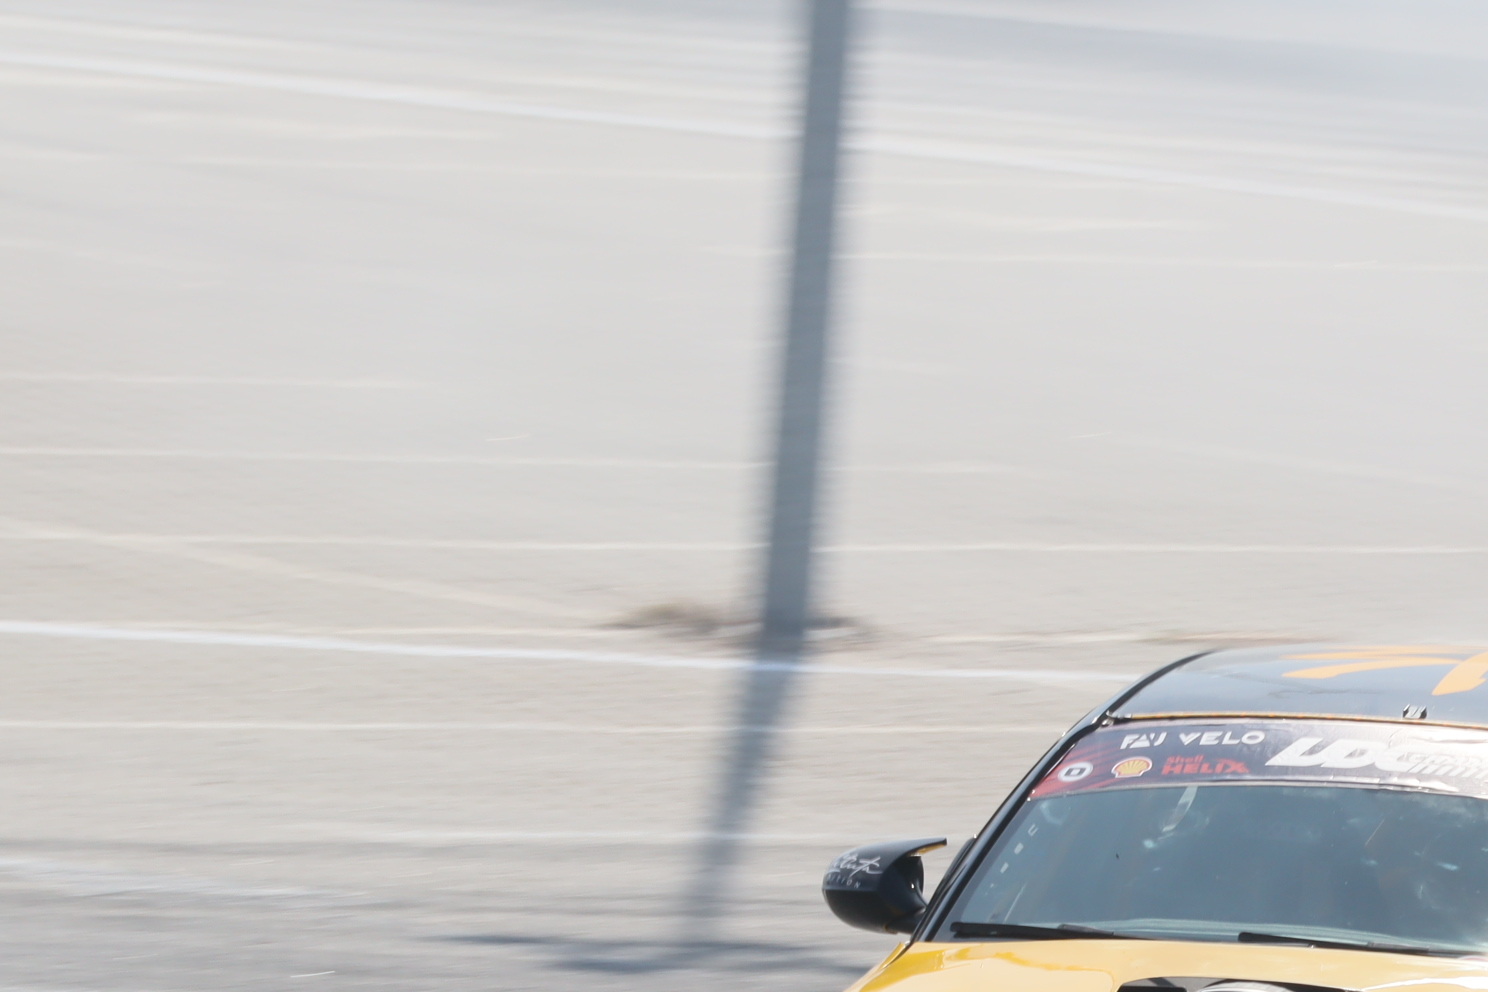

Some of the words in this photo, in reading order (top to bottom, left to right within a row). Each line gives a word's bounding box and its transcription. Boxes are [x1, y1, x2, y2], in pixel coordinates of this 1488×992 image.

[1179, 730, 1266, 746] VELO
[1161, 757, 1250, 775] HELIX
[1167, 754, 1205, 768] Shell
